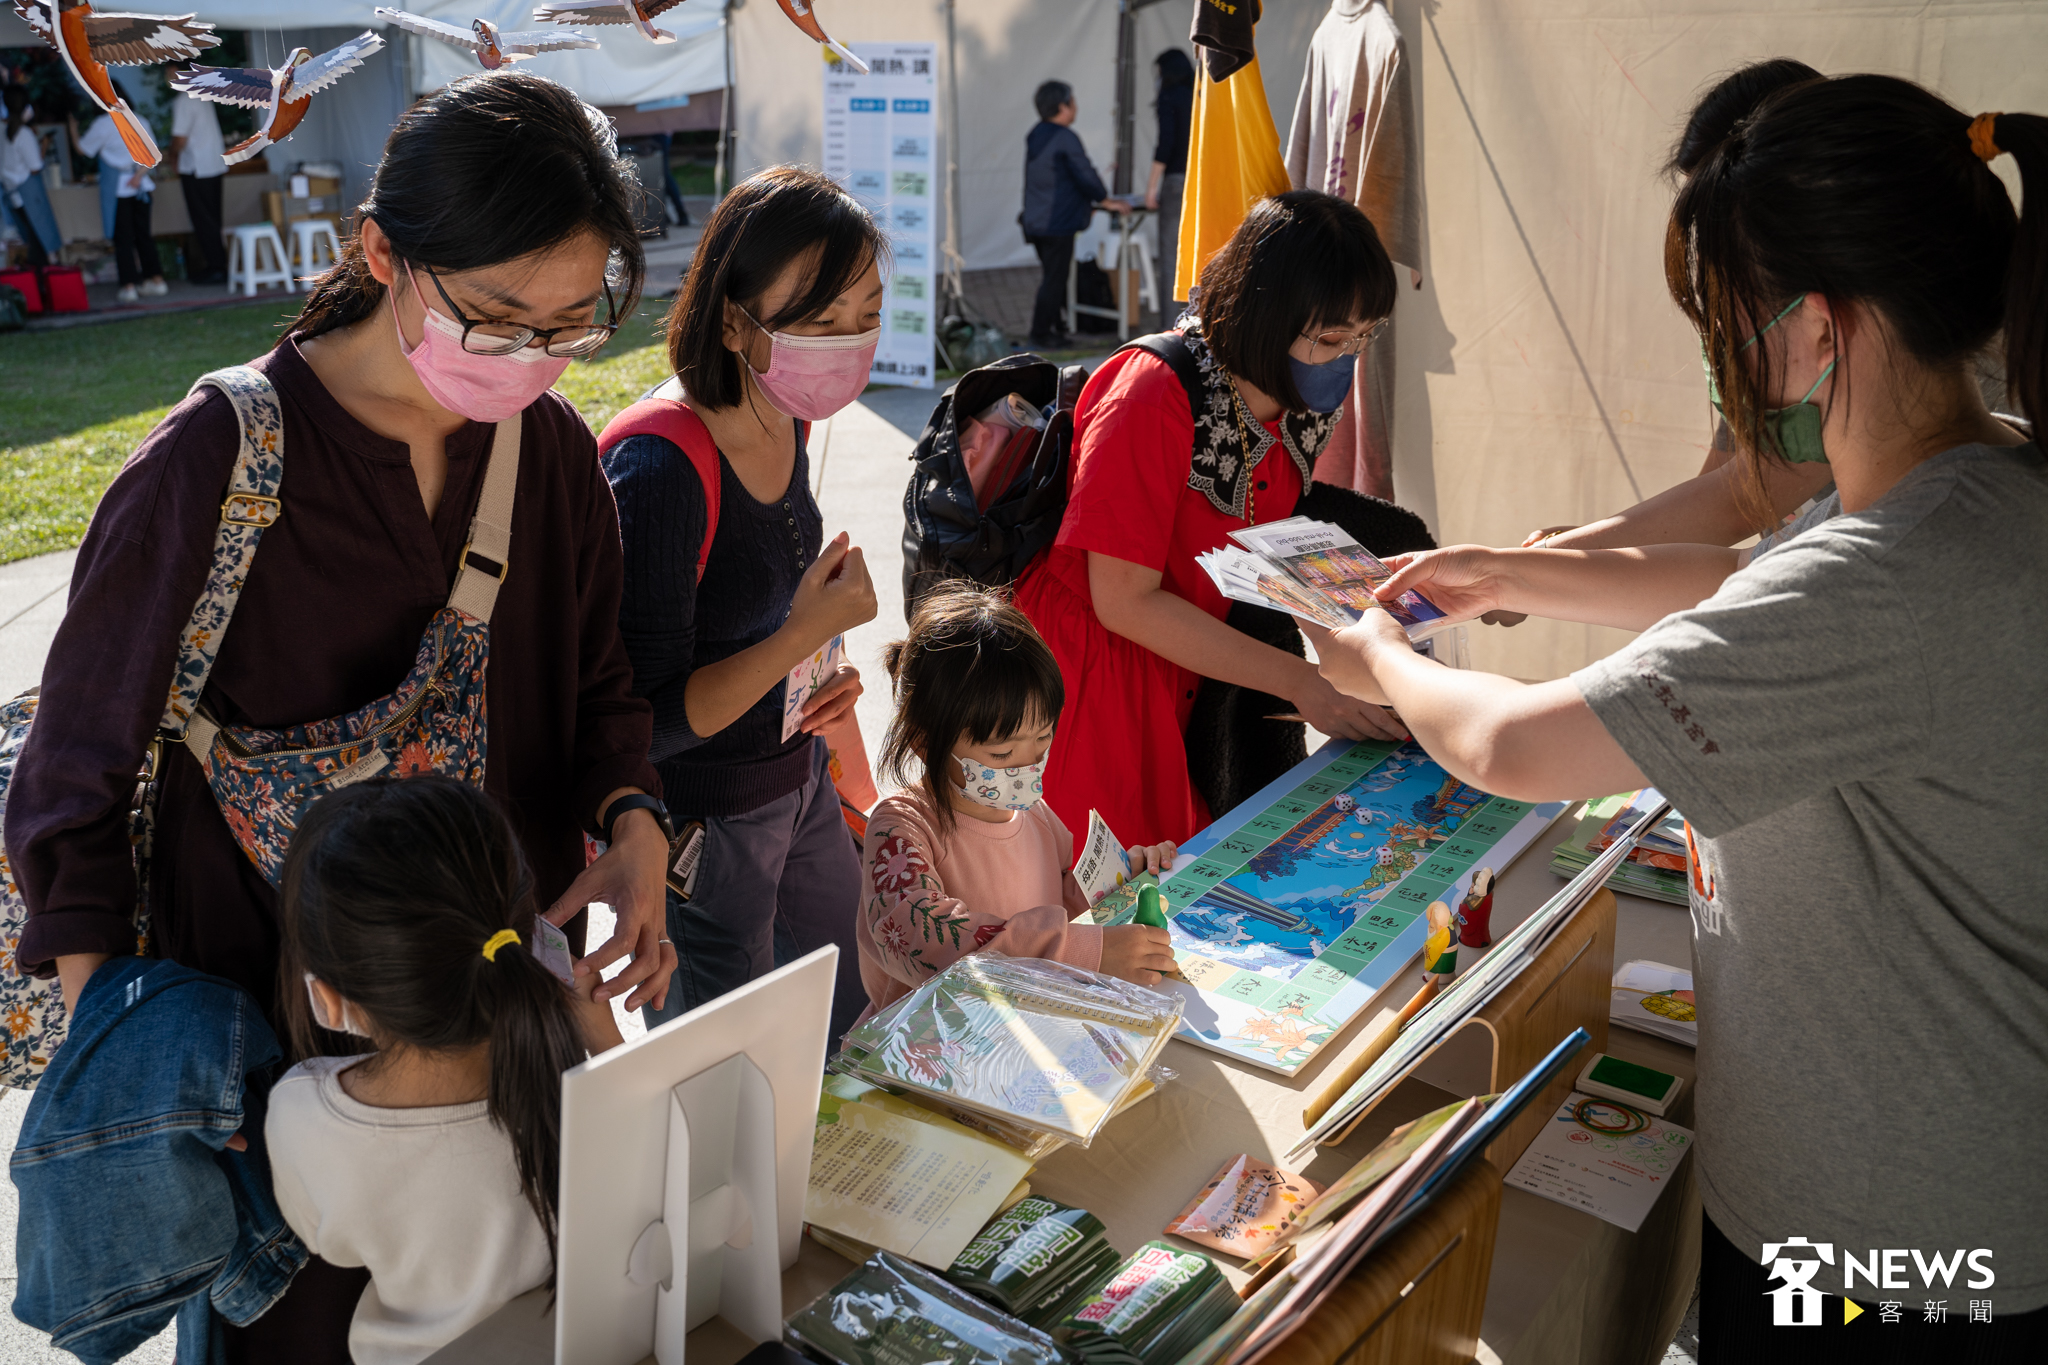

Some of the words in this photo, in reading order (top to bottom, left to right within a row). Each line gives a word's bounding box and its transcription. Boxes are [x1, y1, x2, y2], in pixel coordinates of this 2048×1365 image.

[1370, 915, 1399, 927] 田尾
[1343, 936, 1378, 951] 永靖
[956, 1200, 1051, 1267] 講台語
[1075, 1250, 1175, 1321] 台語家庭
